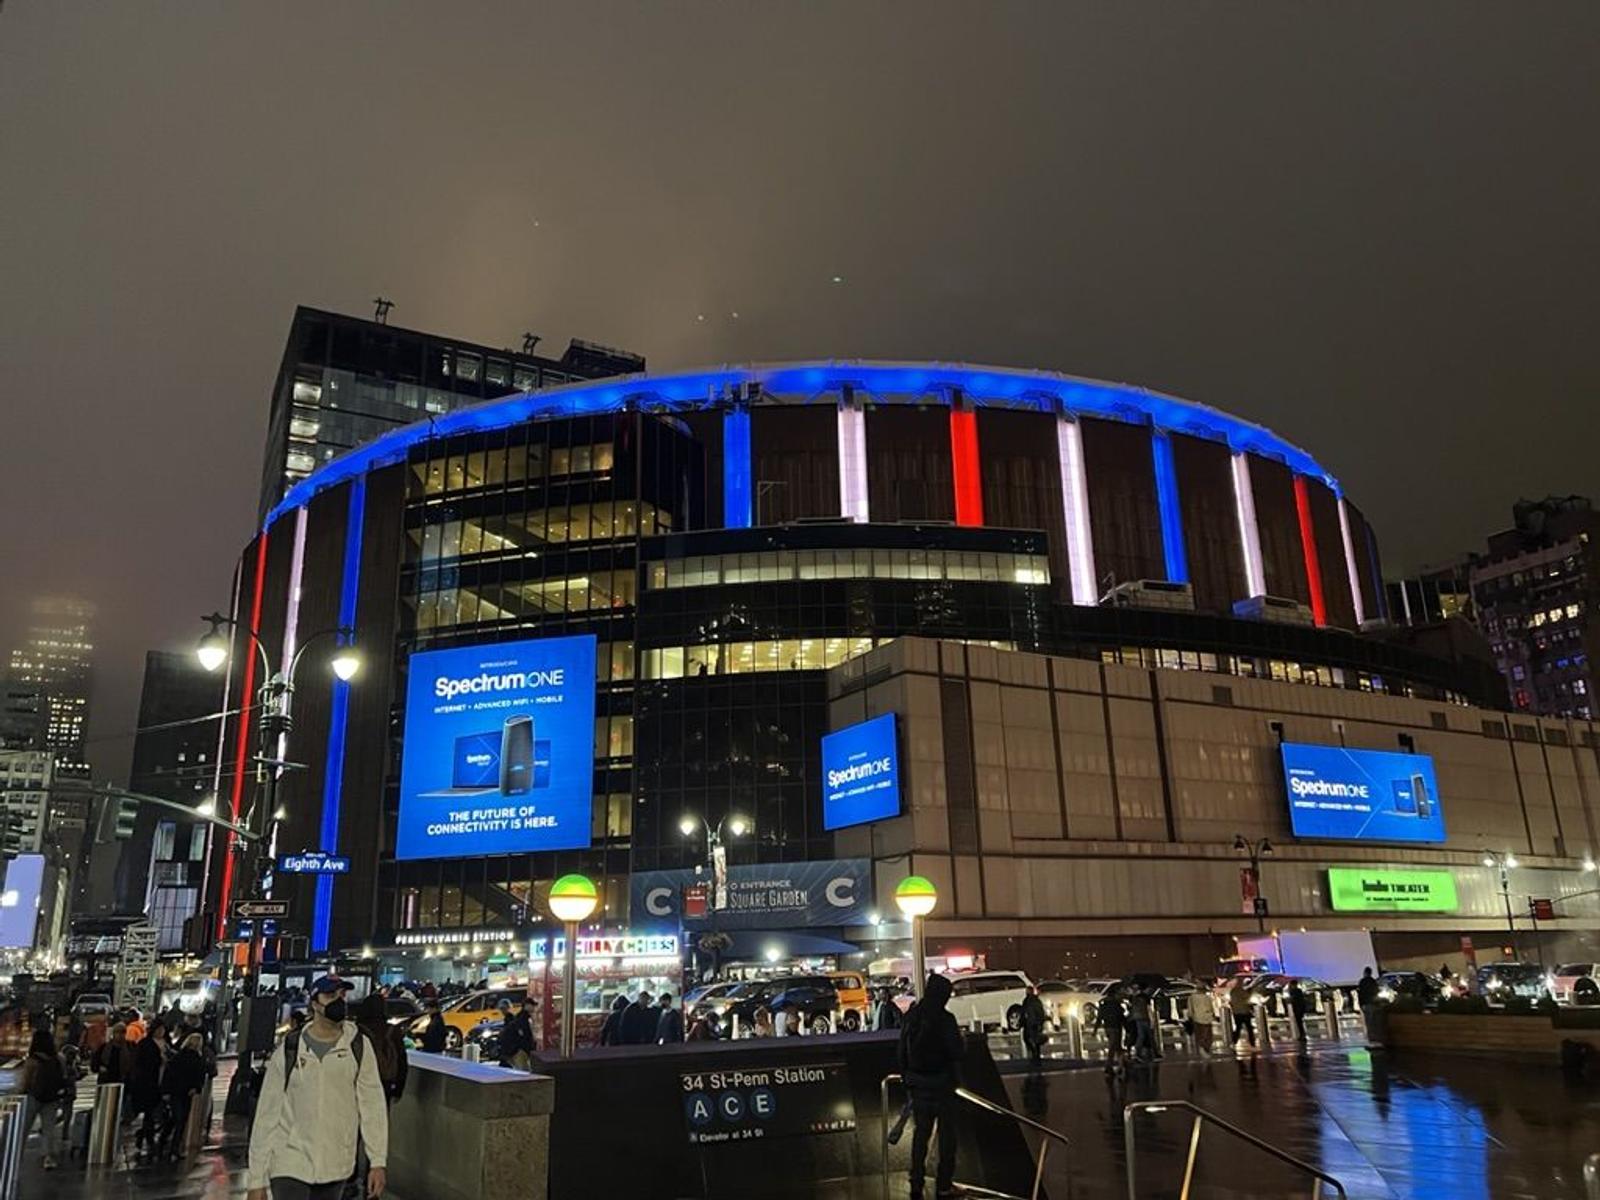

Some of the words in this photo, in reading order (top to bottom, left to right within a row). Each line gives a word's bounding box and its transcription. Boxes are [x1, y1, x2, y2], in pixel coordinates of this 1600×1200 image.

[434, 704, 466, 714] INTERNET
[474, 700, 511, 710] ADVANCED
[536, 695, 563, 704] MOBILE
[449, 810, 469, 822] THE
[472, 807, 516, 820] FUTURE
[519, 806, 535, 817] OF
[427, 819, 508, 836] CONNECTIVITY
[511, 818, 521, 829] IS
[524, 815, 558, 829] HERE.
[285, 857, 320, 871] Eighth
[323, 859, 344, 870] Ave
[740, 880, 791, 889] ENTRANCE
[826, 878, 855, 907] C
[1391, 884, 1430, 893] THEATER
[646, 887, 672, 915] C
[730, 891, 766, 908] SQUARE
[768, 889, 808, 906] GARDEN
[395, 934, 469, 944] PENNSYLVANIA
[473, 931, 514, 942] STATION
[683, 1076, 704, 1090] 34
[710, 1072, 769, 1088] St-Penn
[775, 1068, 825, 1084] Station
[693, 1100, 708, 1118] A
[724, 1097, 739, 1115] C
[756, 1095, 770, 1113] E
[700, 1133, 729, 1142] Elevator
[742, 1130, 752, 1138] 34
